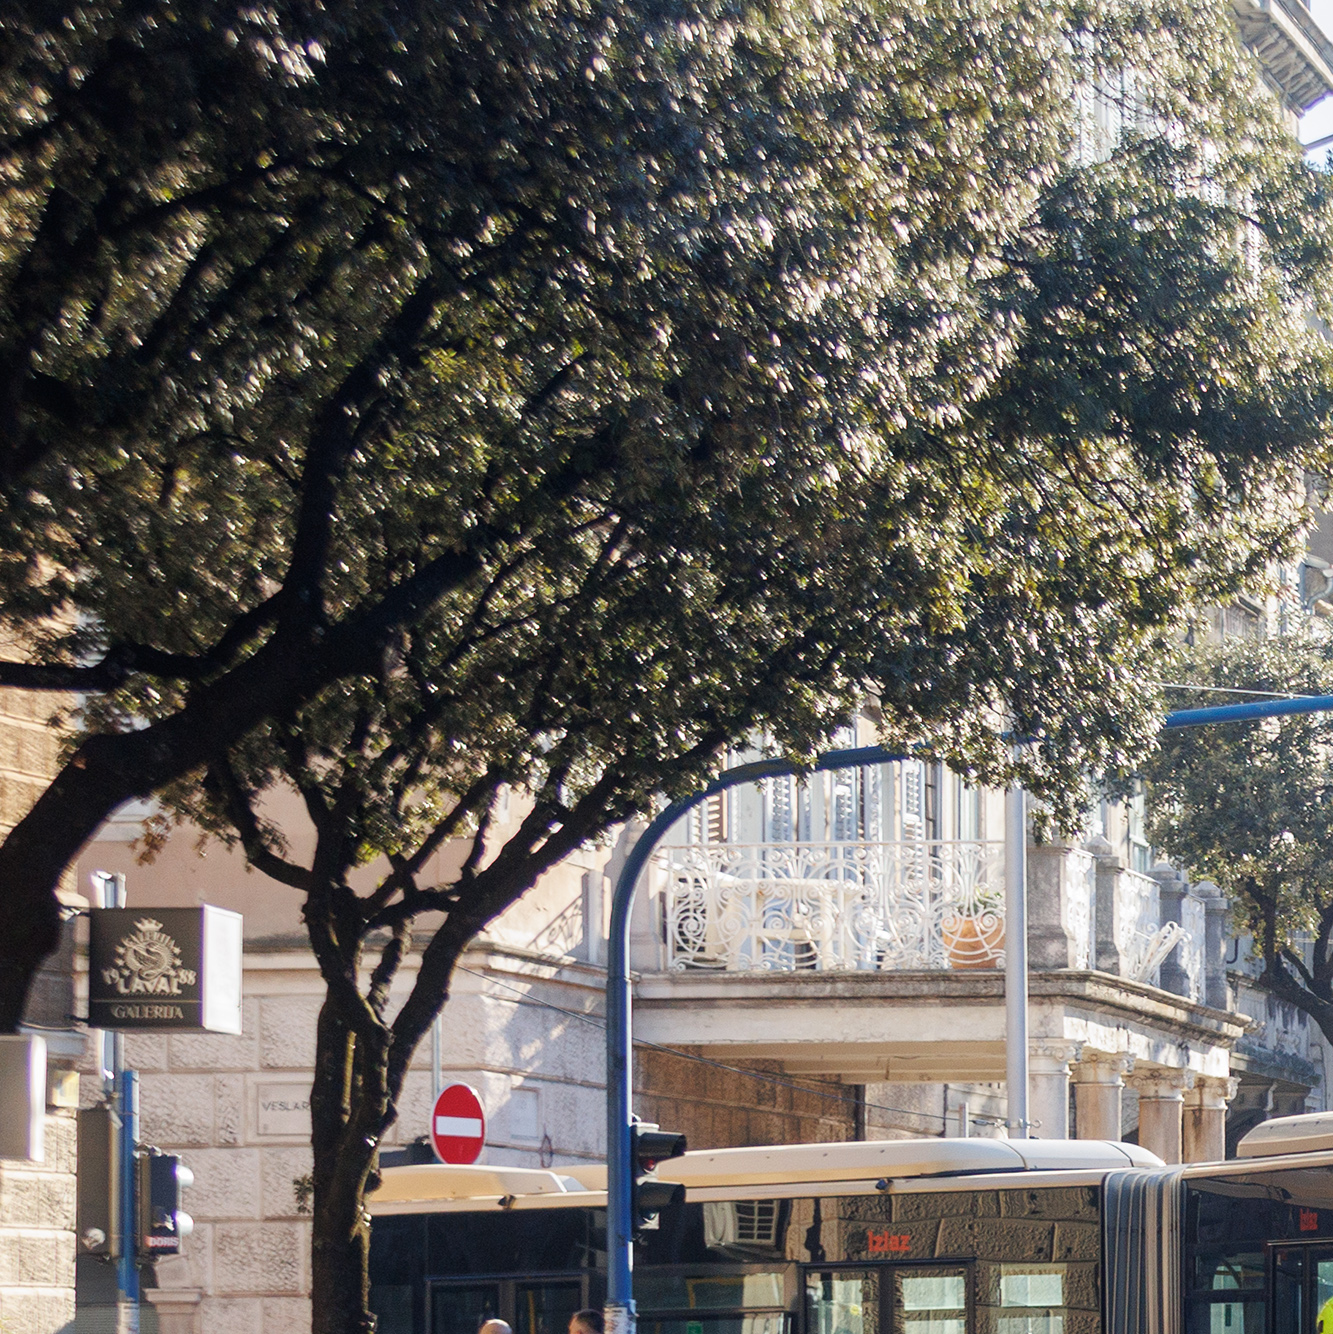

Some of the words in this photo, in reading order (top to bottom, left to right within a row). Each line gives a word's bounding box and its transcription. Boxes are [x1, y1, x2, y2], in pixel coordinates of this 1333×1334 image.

[117, 976, 182, 994] LAVAL
[111, 1004, 184, 1019] GALERIJA
[868, 1230, 910, 1251] Izlaz
